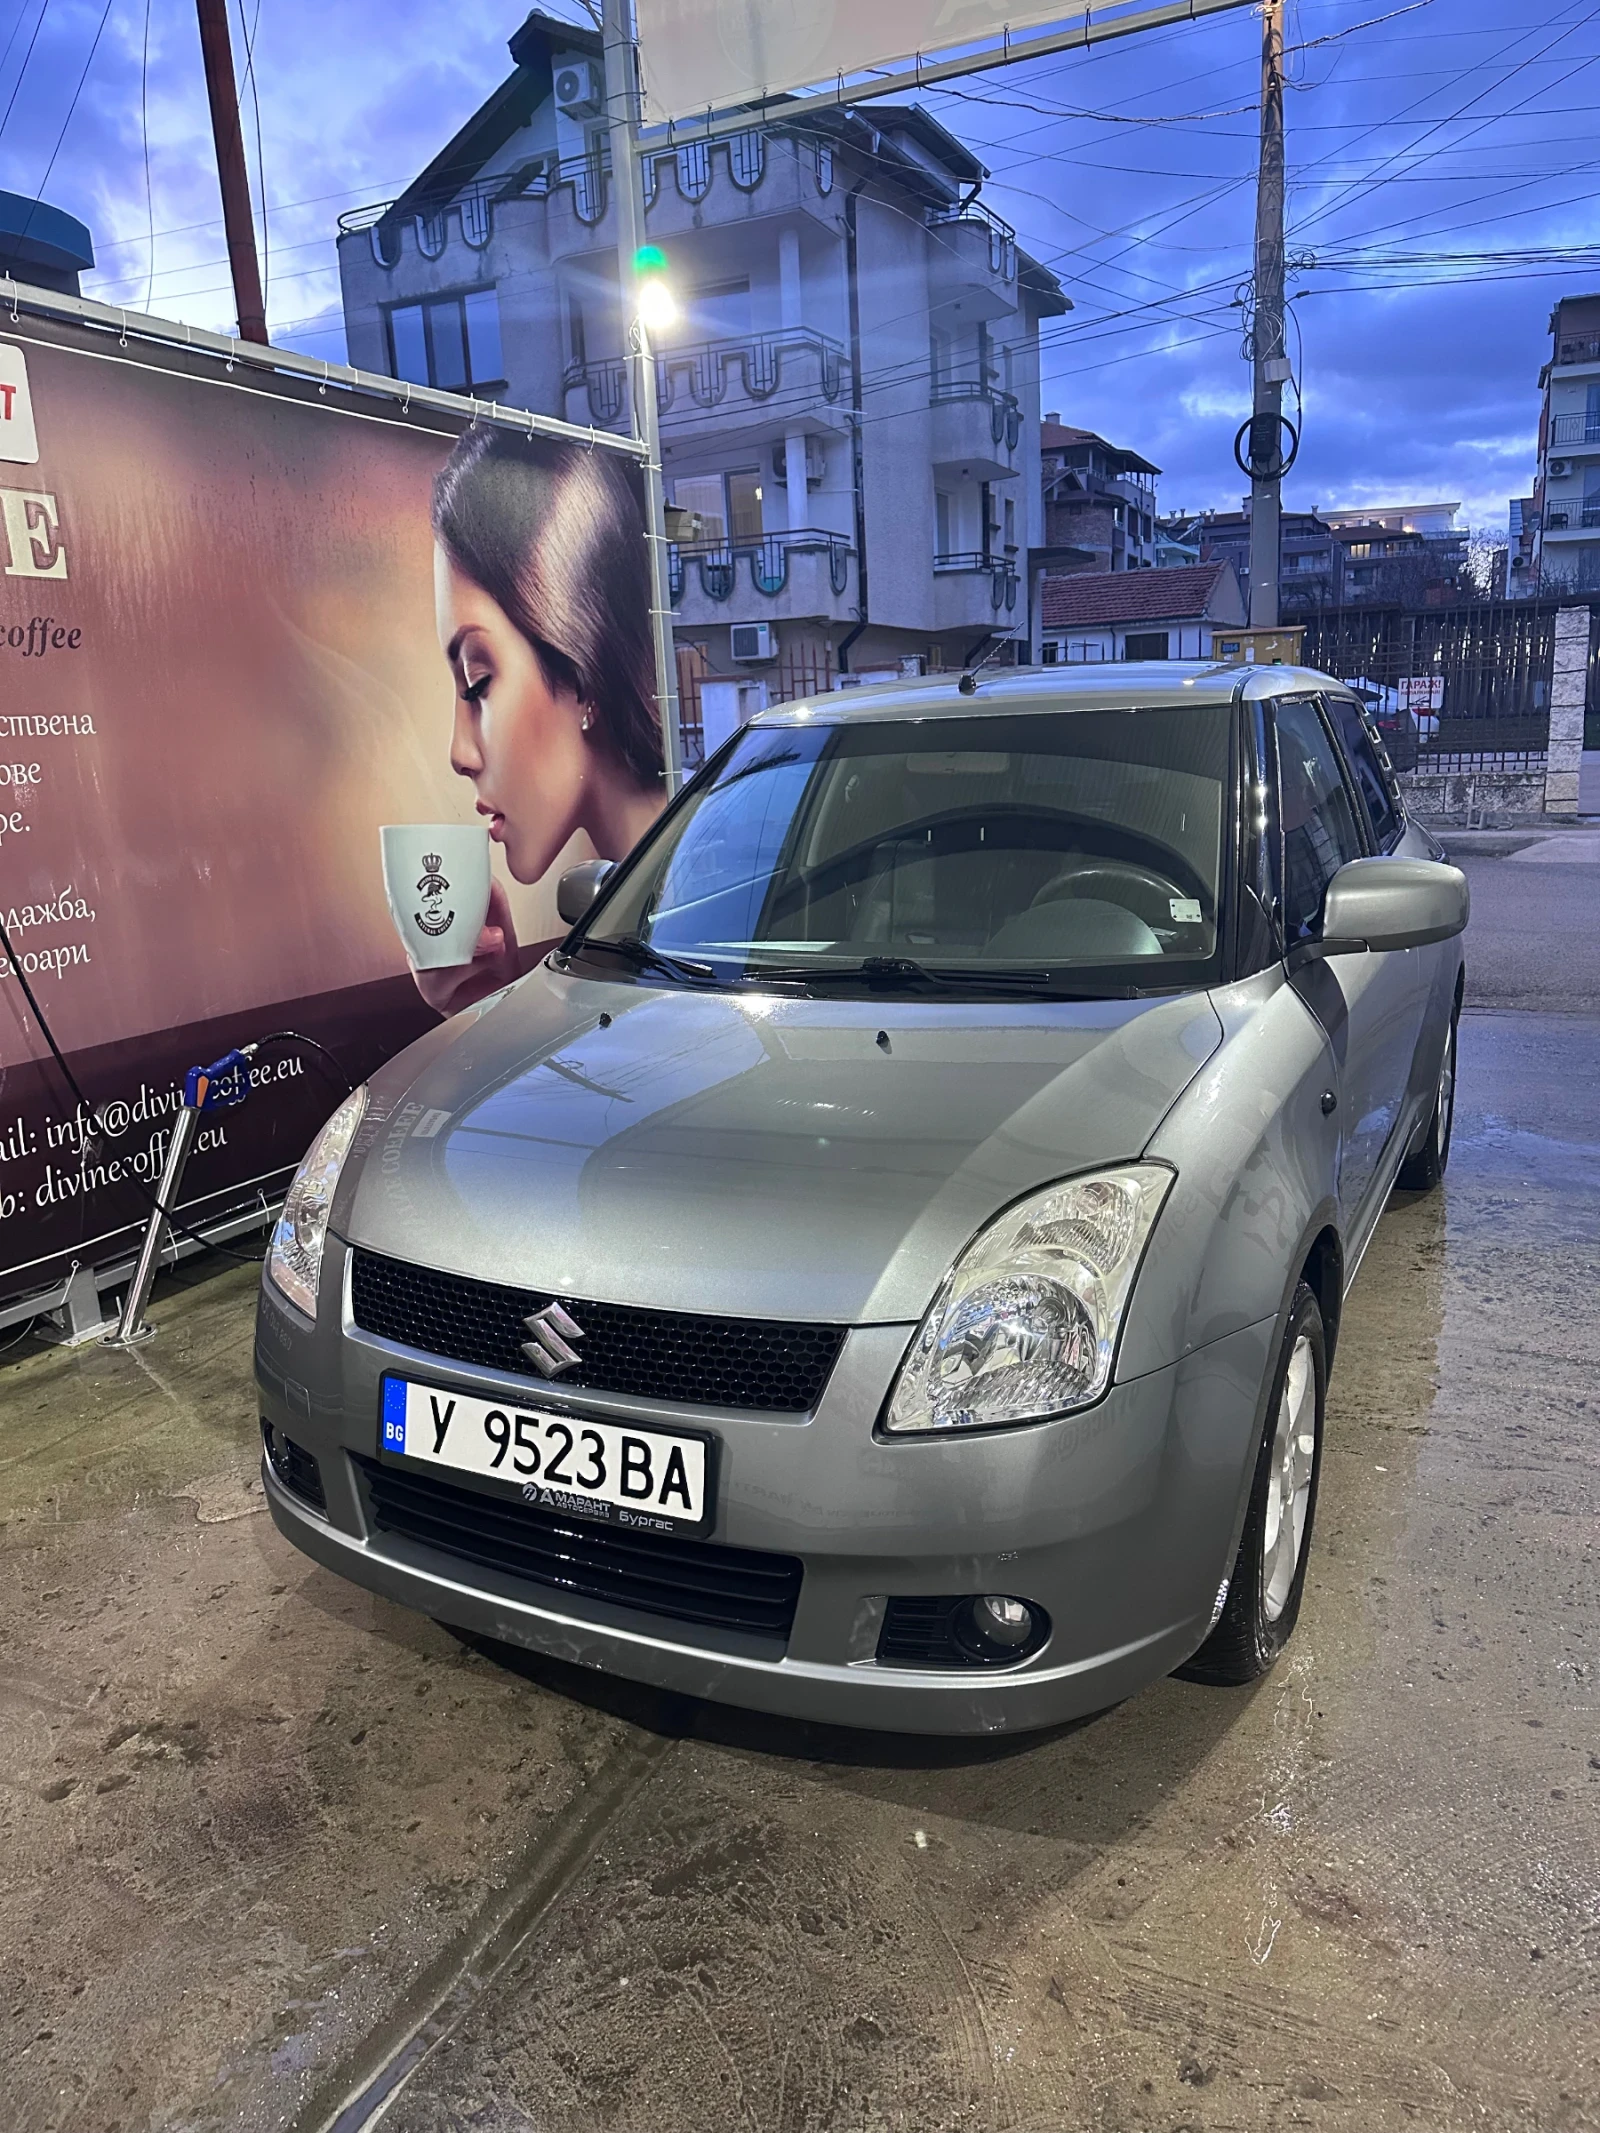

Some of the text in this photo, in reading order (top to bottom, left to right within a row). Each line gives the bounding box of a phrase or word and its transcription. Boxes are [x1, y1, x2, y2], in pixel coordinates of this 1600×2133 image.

[1401, 680, 1441, 690] ГАРАЖ!
[0, 884, 96, 938] дажба,
[386, 1421, 404, 1442] BG
[483, 1410, 607, 1489] 9523
